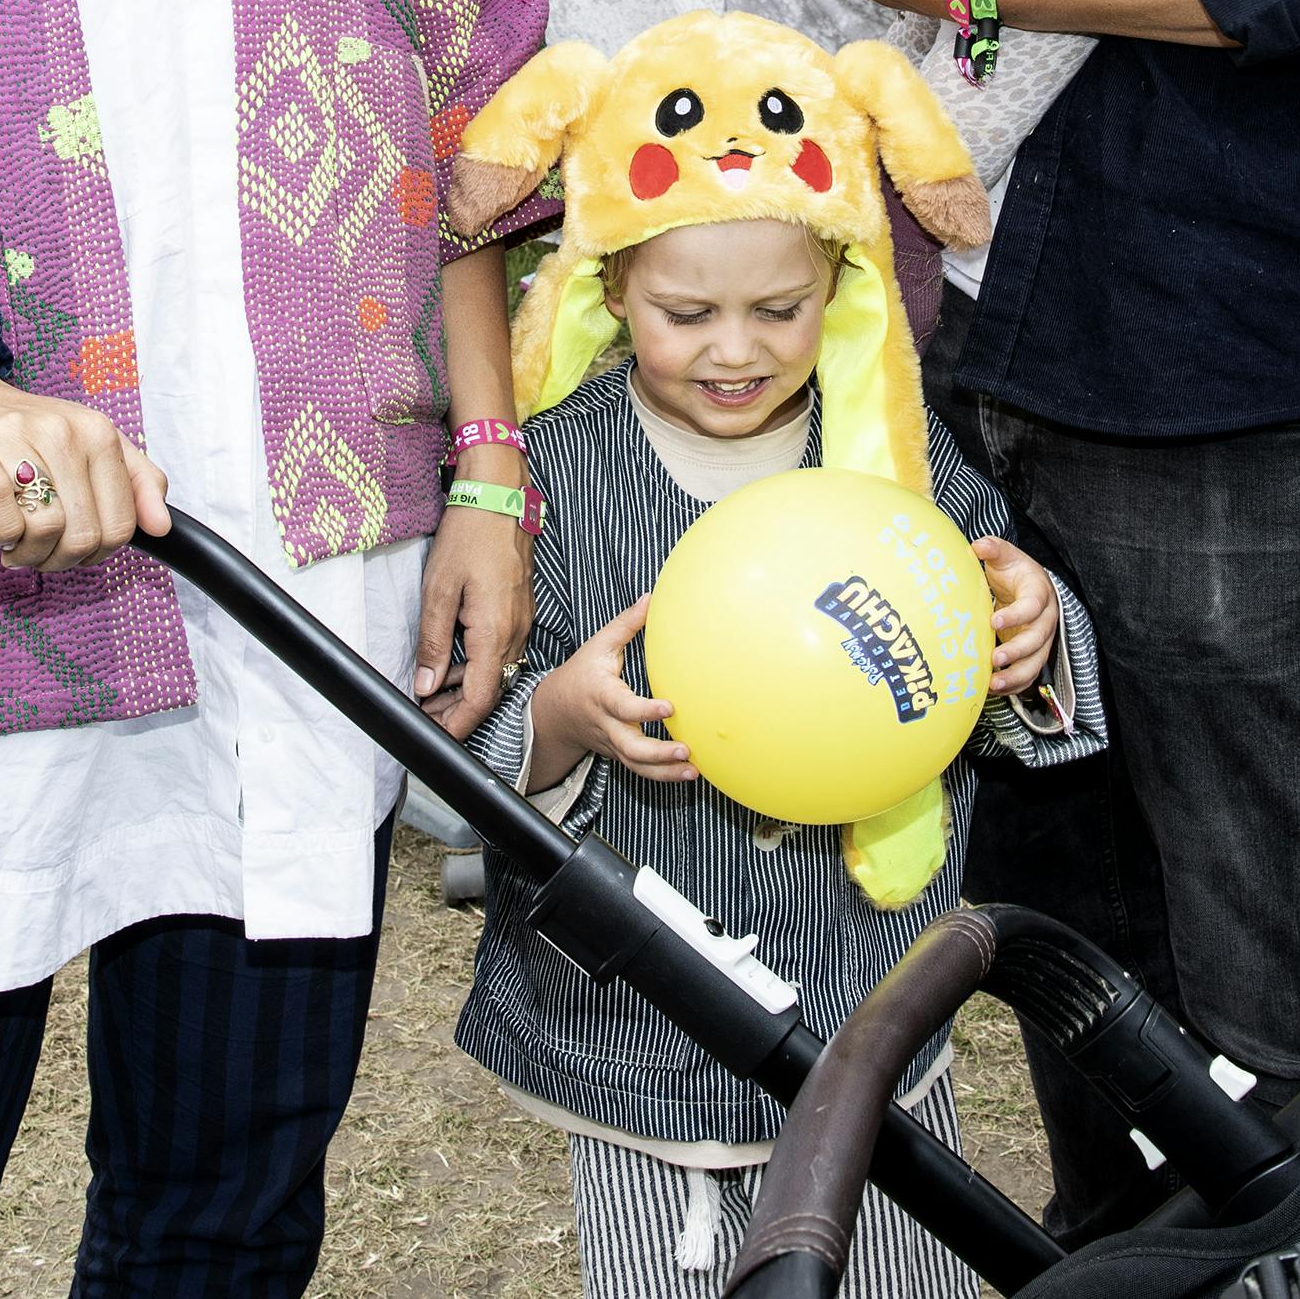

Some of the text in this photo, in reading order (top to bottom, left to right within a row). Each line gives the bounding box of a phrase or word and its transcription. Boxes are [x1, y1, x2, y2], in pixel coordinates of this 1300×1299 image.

[460, 494, 478, 505] VIG
[876, 526, 958, 661] CINEMAS
[824, 599, 911, 712] DETECTIVE
[952, 609, 980, 699] MAY
